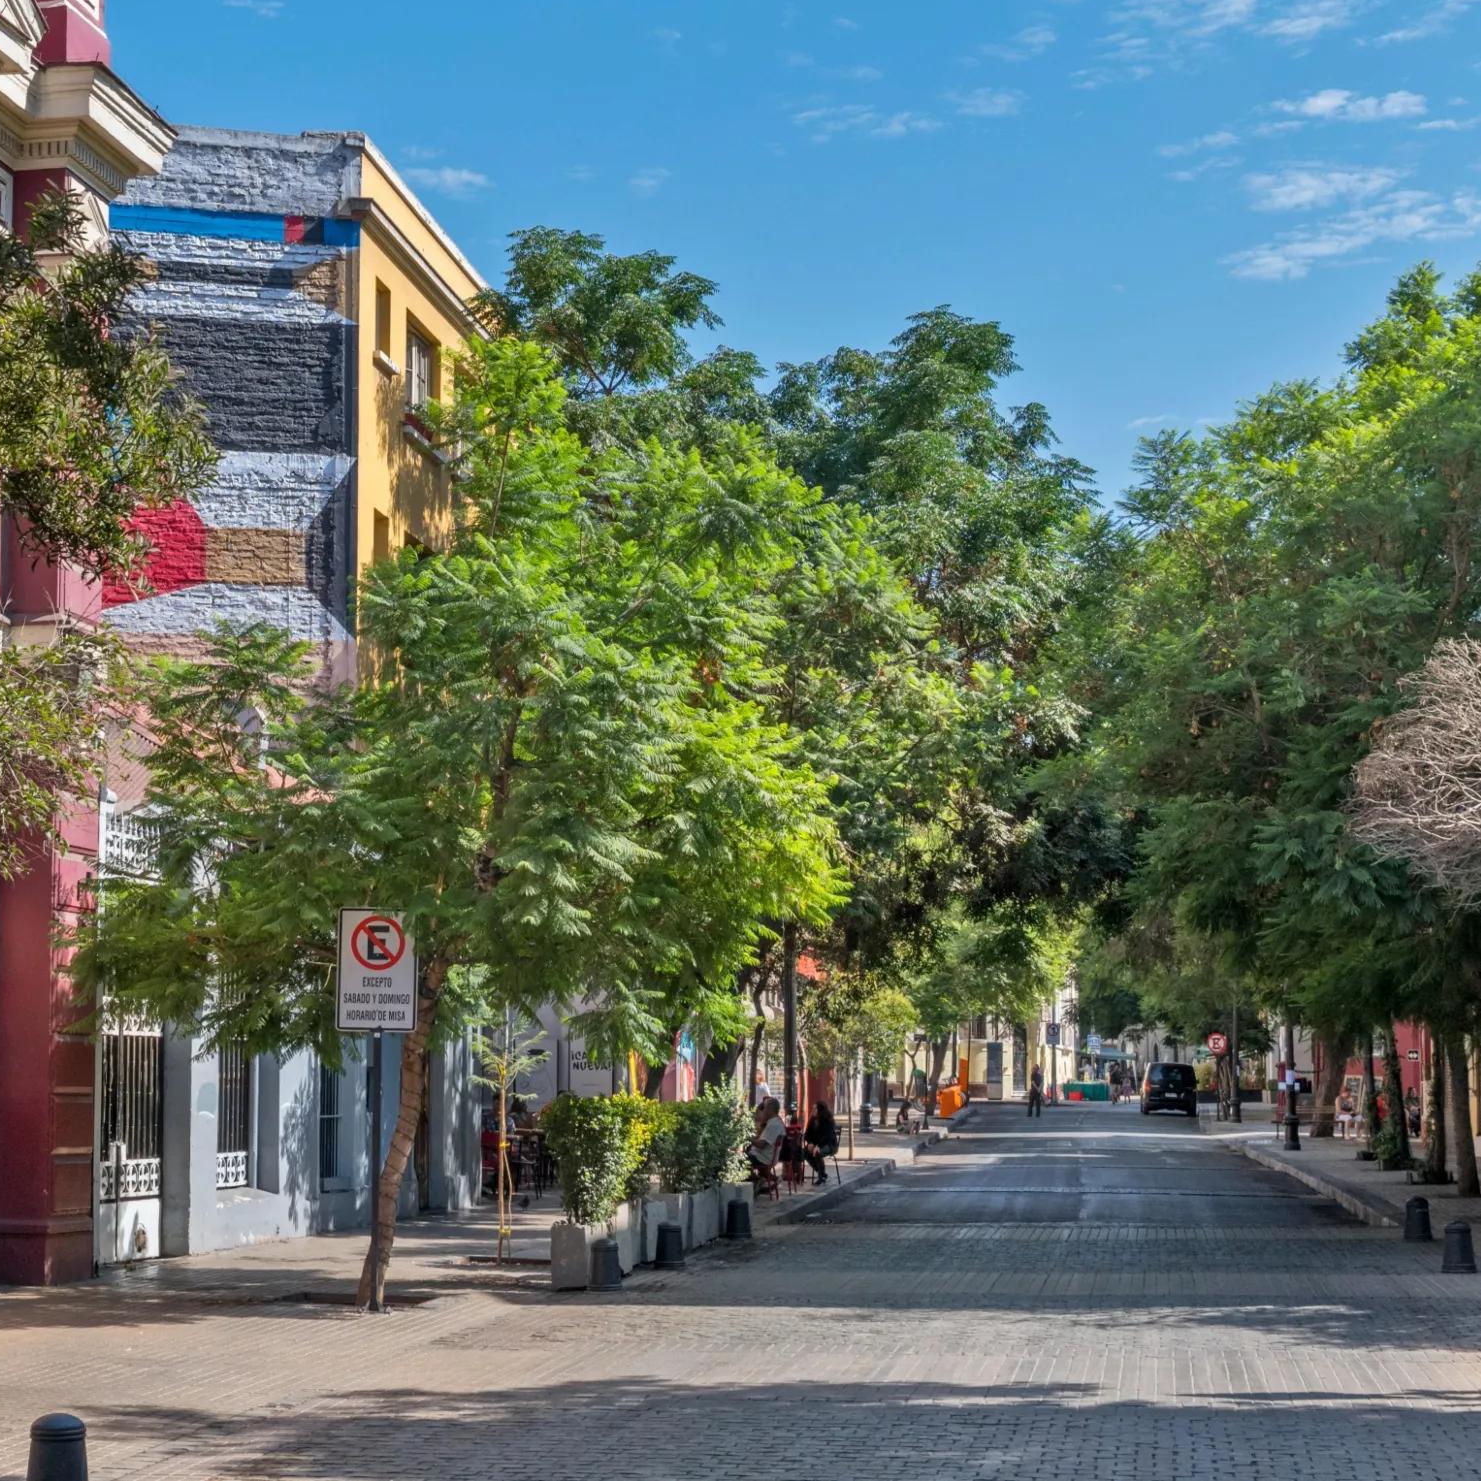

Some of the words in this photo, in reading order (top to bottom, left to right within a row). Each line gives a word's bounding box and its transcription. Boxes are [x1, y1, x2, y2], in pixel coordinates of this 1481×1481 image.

[362, 976, 393, 988] EXCEPTO
[343, 992, 371, 1004] SABADO
[372, 993, 377, 1004] Y
[378, 993, 410, 1005] DOMINGO
[346, 1010, 377, 1021] HORARIO
[378, 1010, 387, 1021] DE
[388, 1010, 406, 1021] MISA
